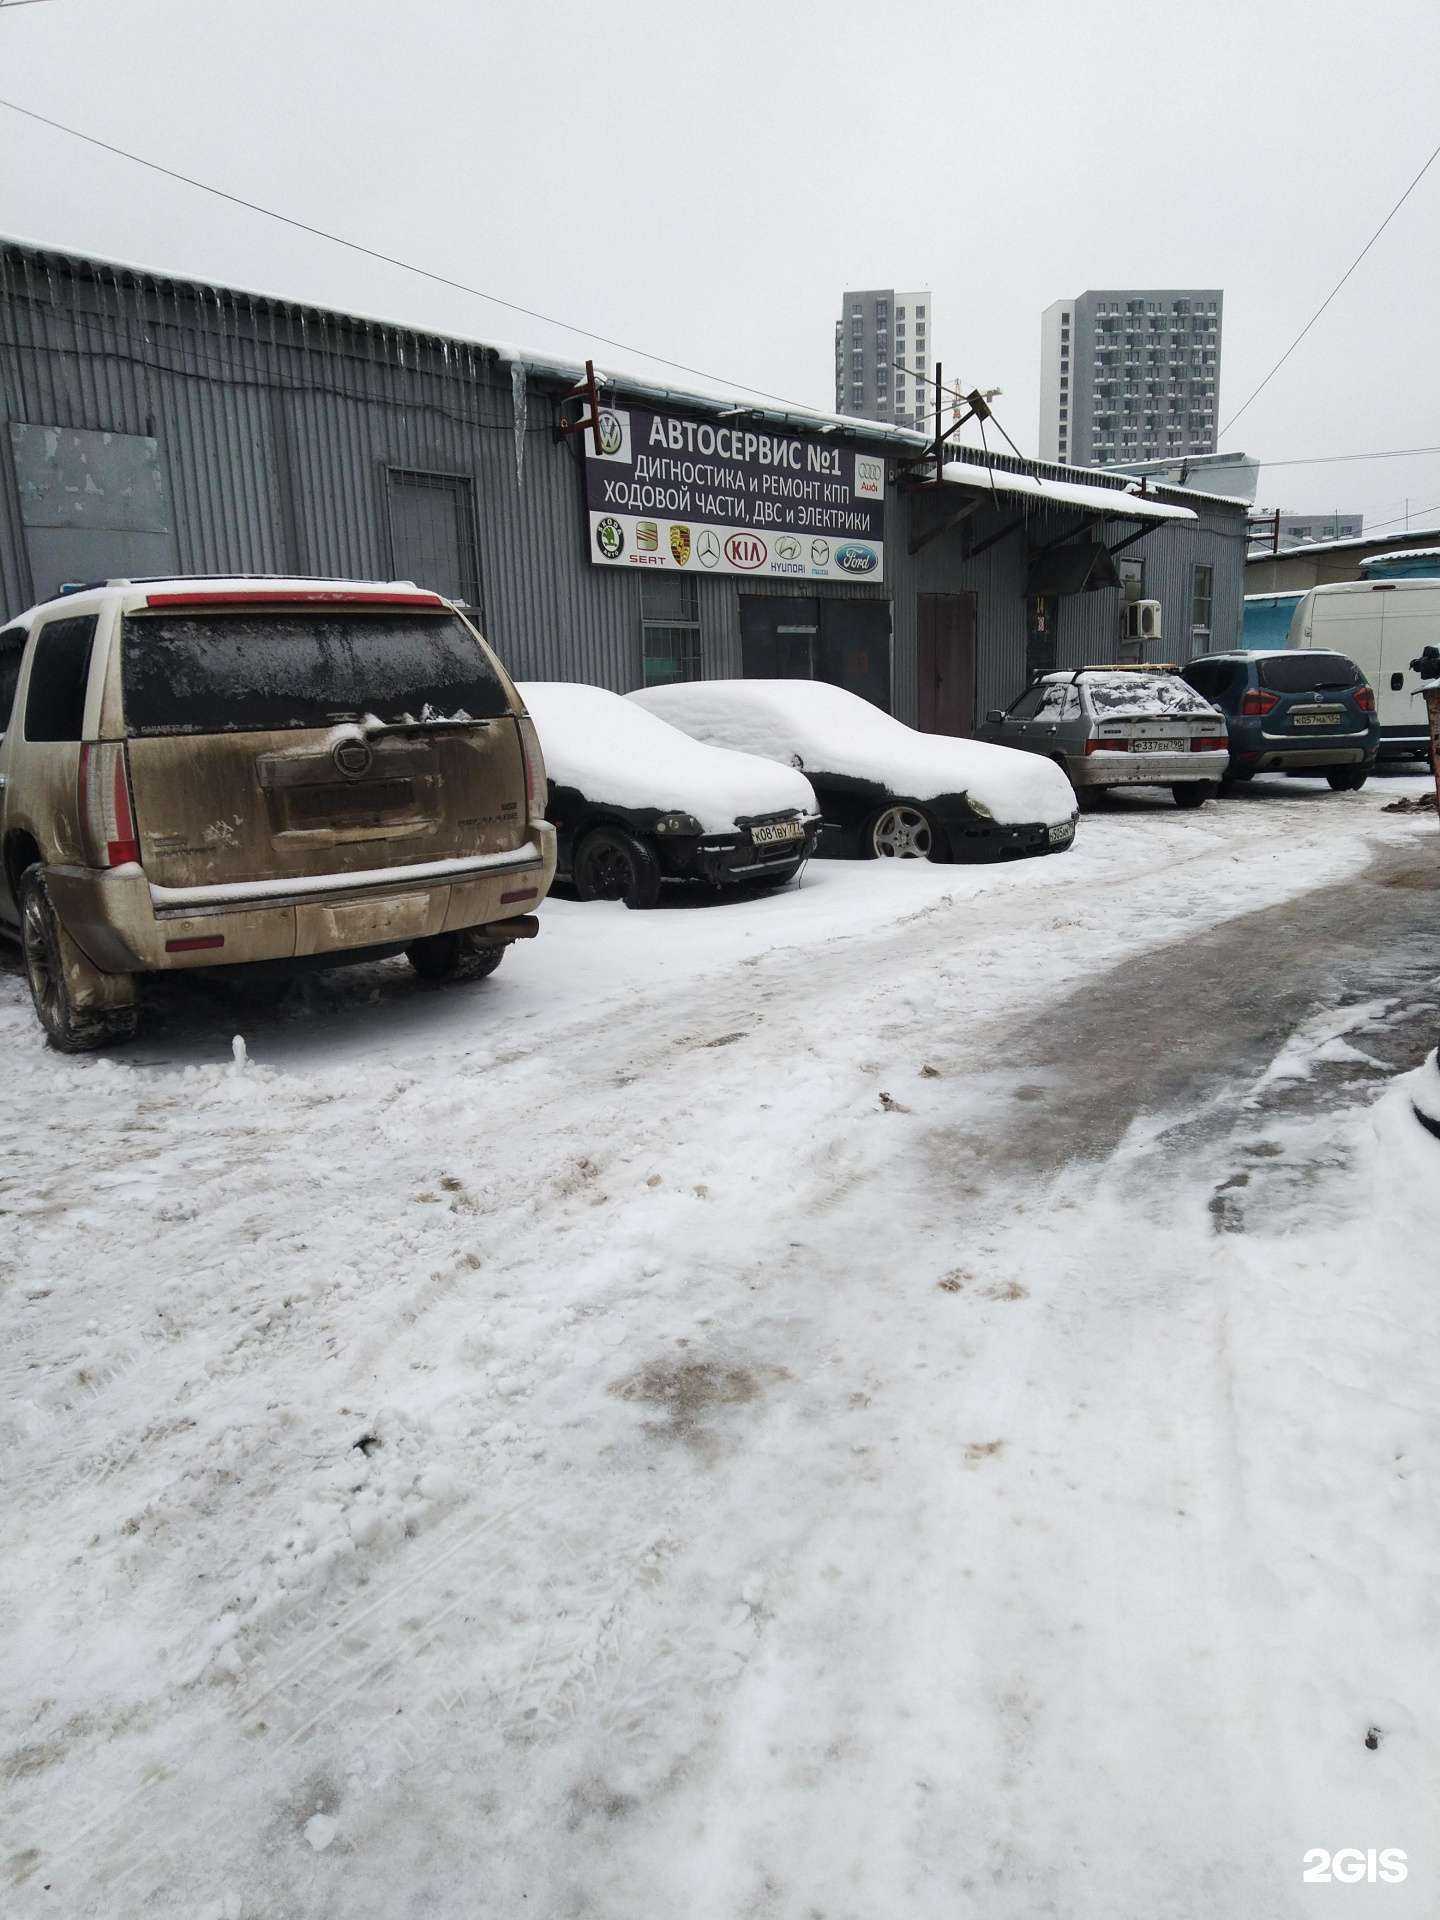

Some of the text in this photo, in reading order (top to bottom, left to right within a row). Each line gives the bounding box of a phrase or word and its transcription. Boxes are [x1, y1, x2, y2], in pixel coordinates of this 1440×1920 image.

[648, 415, 842, 476] АВТОСЕРВИС №1
[634, 454, 850, 504] ДИГНОСТИКА и РЕМОНТ КПП
[860, 481, 878, 492] Audi
[604, 479, 871, 532] ХОДОВОЙ ЧАСТИ, ДВС и ЭЛЕКТРИКИ
[629, 554, 666, 565] SEAT
[731, 540, 760, 563] KIA
[843, 552, 870, 569] Ford
[770, 562, 806, 574] HYUNDAI
